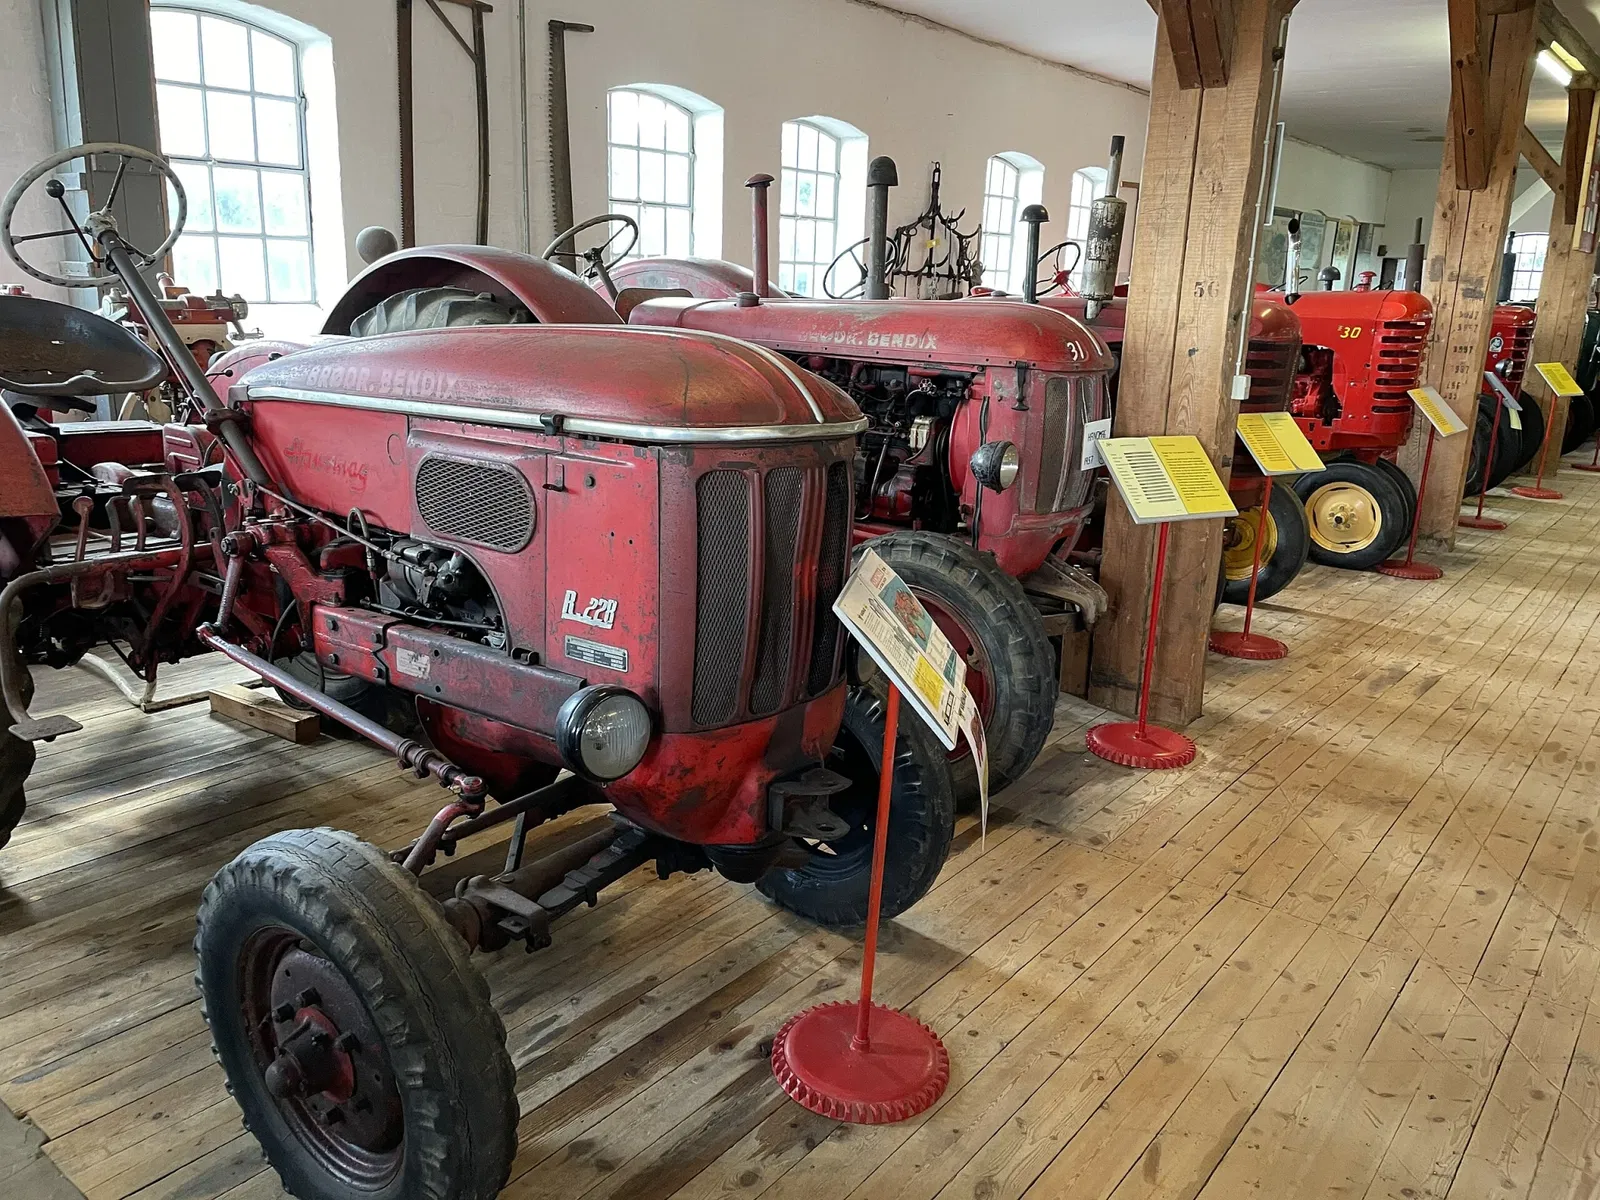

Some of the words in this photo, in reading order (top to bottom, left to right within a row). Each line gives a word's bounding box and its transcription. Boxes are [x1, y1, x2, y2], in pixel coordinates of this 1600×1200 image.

[1339, 326, 1362, 339] 30
[1066, 340, 1085, 361] 31
[378, 368, 460, 399] BENDIX
